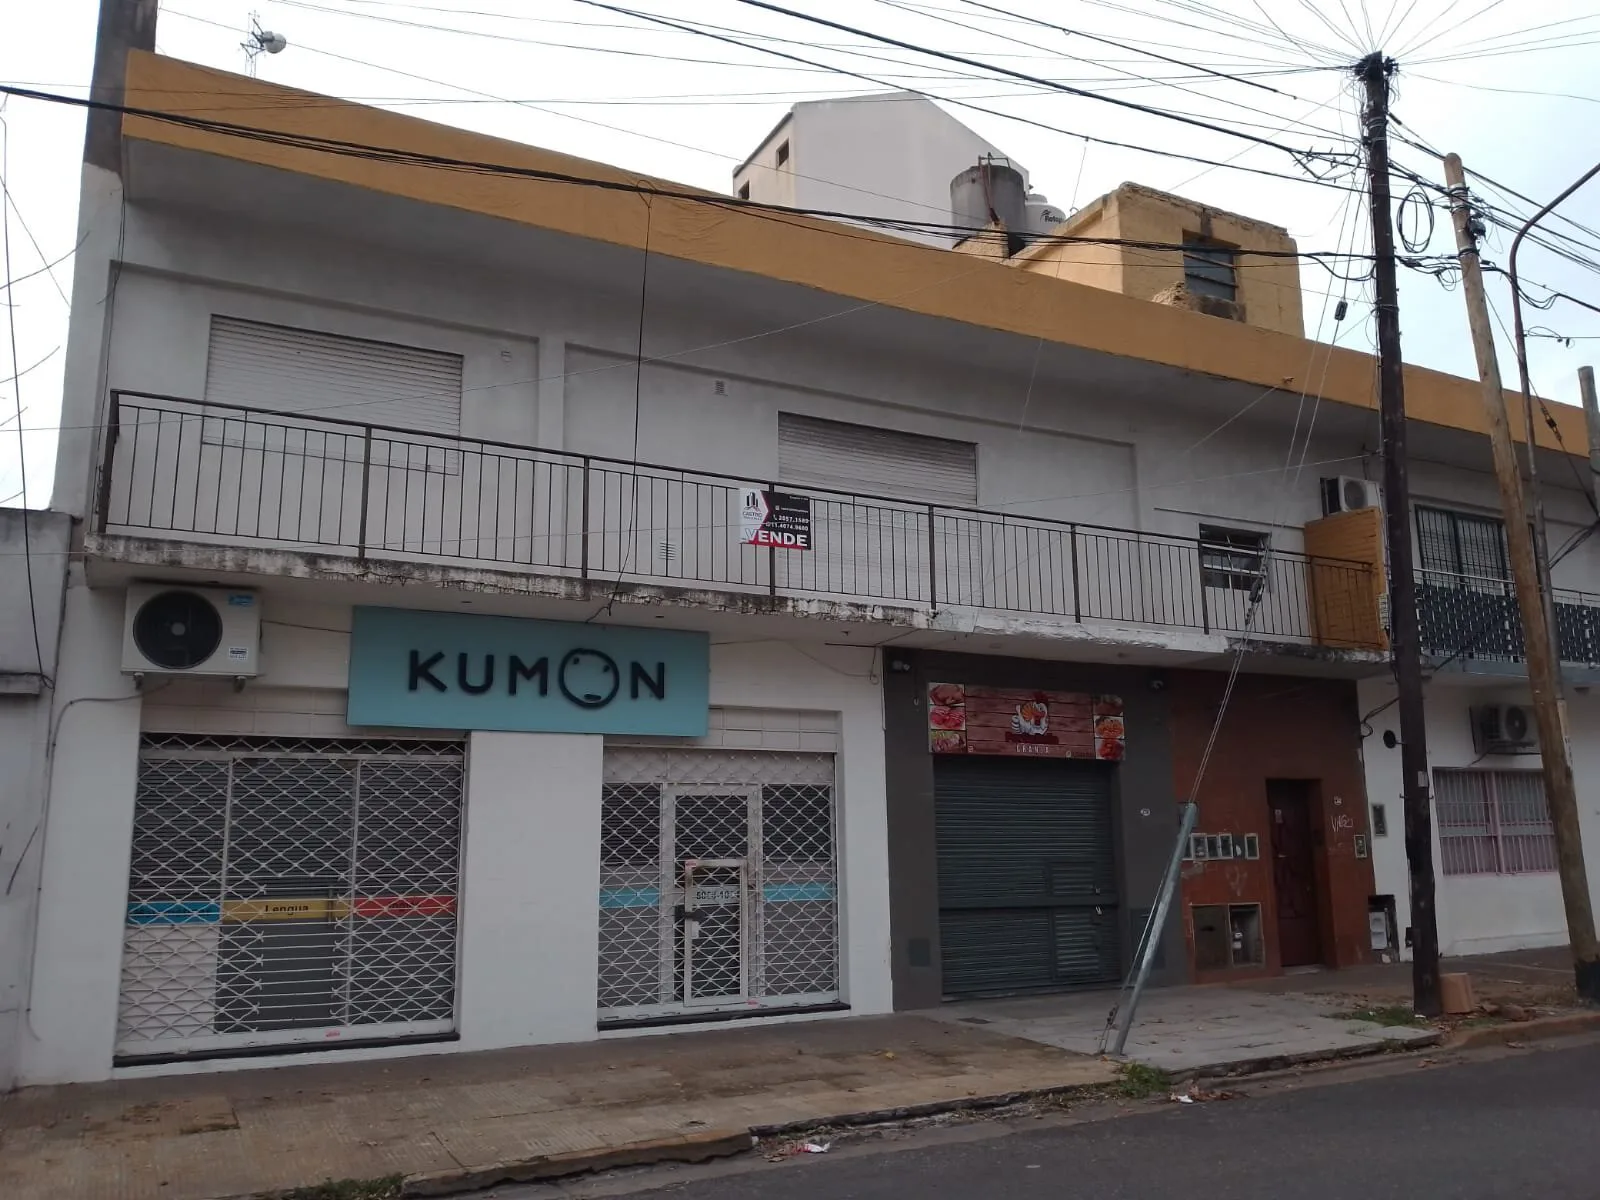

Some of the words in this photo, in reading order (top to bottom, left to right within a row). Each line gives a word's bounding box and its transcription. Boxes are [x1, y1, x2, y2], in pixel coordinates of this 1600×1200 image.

[744, 528, 808, 547] VENDE
[408, 647, 666, 710] KUMON
[265, 904, 309, 916] Lengua
